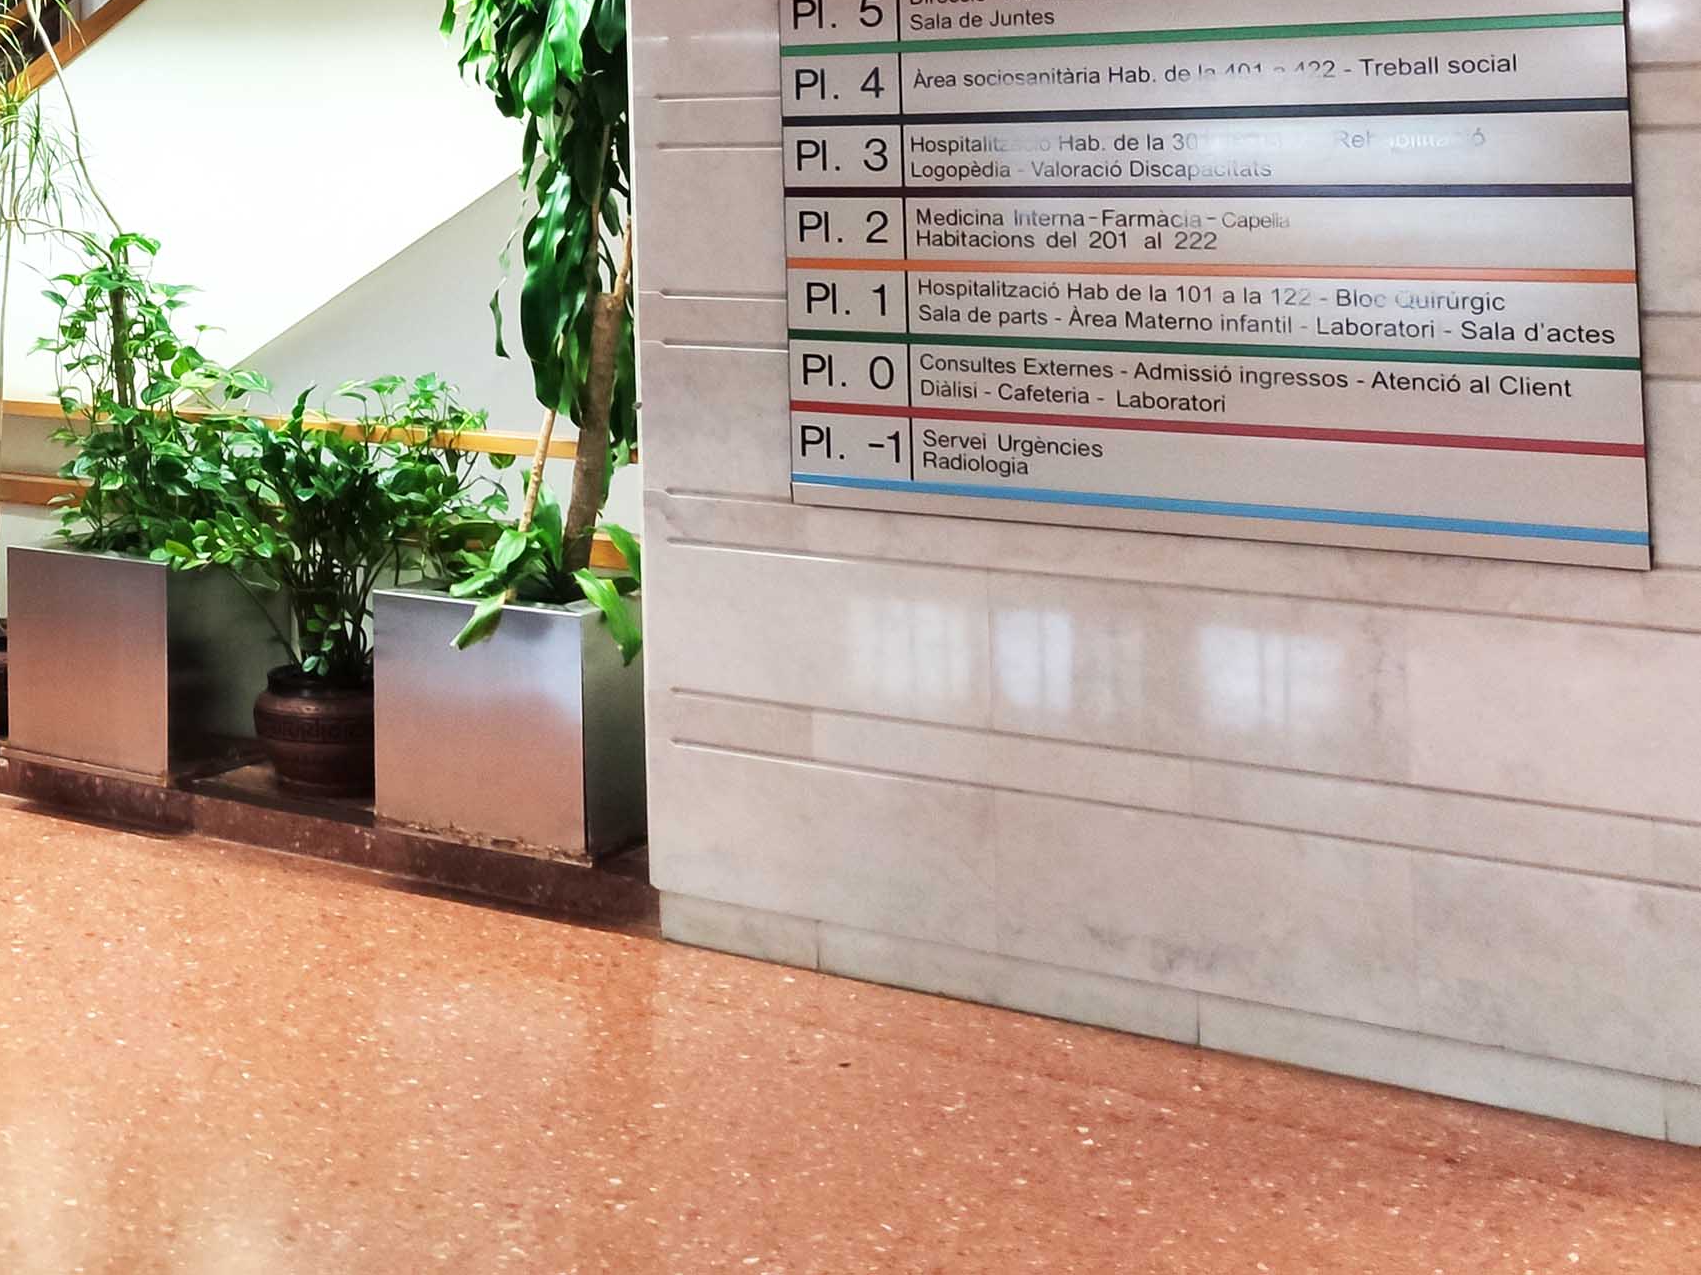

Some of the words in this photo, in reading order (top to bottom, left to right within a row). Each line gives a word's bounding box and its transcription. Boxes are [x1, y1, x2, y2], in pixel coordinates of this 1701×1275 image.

[910, 13, 952, 31] Sala
[958, 11, 983, 29] de
[989, 9, 1055, 27] Juntes
[795, 68, 839, 101] Pl.
[859, 66, 885, 99] 4
[913, 68, 957, 89] Àrea
[963, 67, 1100, 87] sociosanitària
[1108, 65, 1157, 84] Hab.
[1165, 64, 1191, 83] de
[1359, 55, 1439, 77] Treball
[1447, 53, 1518, 74] social
[797, 139, 841, 172] Pl.
[862, 137, 889, 172] 3
[1058, 133, 1106, 152] Hab.
[1114, 133, 1140, 152] de
[1147, 133, 1164, 151] la
[910, 160, 1011, 181] Logopèdia
[1031, 159, 1122, 178] Valoració
[798, 210, 843, 243] Pl.
[865, 210, 889, 244] 2
[916, 208, 1004, 226] Medicina
[916, 230, 1035, 249] Habitacions
[1046, 230, 1076, 249] del
[1088, 231, 1127, 249] 201
[1144, 231, 1162, 250] al
[1174, 231, 1218, 251] 222
[806, 282, 851, 316] Pl.
[872, 284, 887, 317] 1
[917, 278, 1060, 299] Hospitalització
[1067, 282, 1109, 301] Hab
[1116, 283, 1142, 302] de
[1149, 284, 1167, 302] la
[1175, 285, 1213, 304] 101
[1222, 291, 1235, 304] a
[1243, 287, 1262, 305] la
[1271, 288, 1312, 307] 122
[1336, 289, 1387, 308] Bloc
[918, 305, 962, 323] Sala
[967, 305, 992, 324] de
[998, 308, 1048, 328] parts
[1068, 306, 1118, 328] Àrea
[1125, 311, 1213, 331] Materno
[1220, 312, 1293, 334] infantil
[1316, 317, 1435, 339] Laboratori
[1460, 321, 1515, 342] Sala
[1524, 322, 1616, 345] d'actes
[802, 353, 847, 388] Pl.
[868, 355, 895, 390] 0
[919, 353, 1017, 375] Consultes
[1023, 357, 1114, 379] Externes
[1133, 361, 1232, 383] Admissió
[1239, 366, 1349, 389] ingressos
[1370, 371, 1461, 393] Atenció
[1470, 375, 1490, 395] al
[1499, 375, 1572, 398] Client
[921, 379, 978, 400] Diàlisi
[998, 383, 1090, 405] Cafeteria
[1116, 390, 1227, 413] Laboratori
[800, 424, 846, 460] Pl.
[922, 429, 987, 450] Servei
[997, 433, 1104, 459] Urgències
[922, 452, 1029, 476] Radiologia
